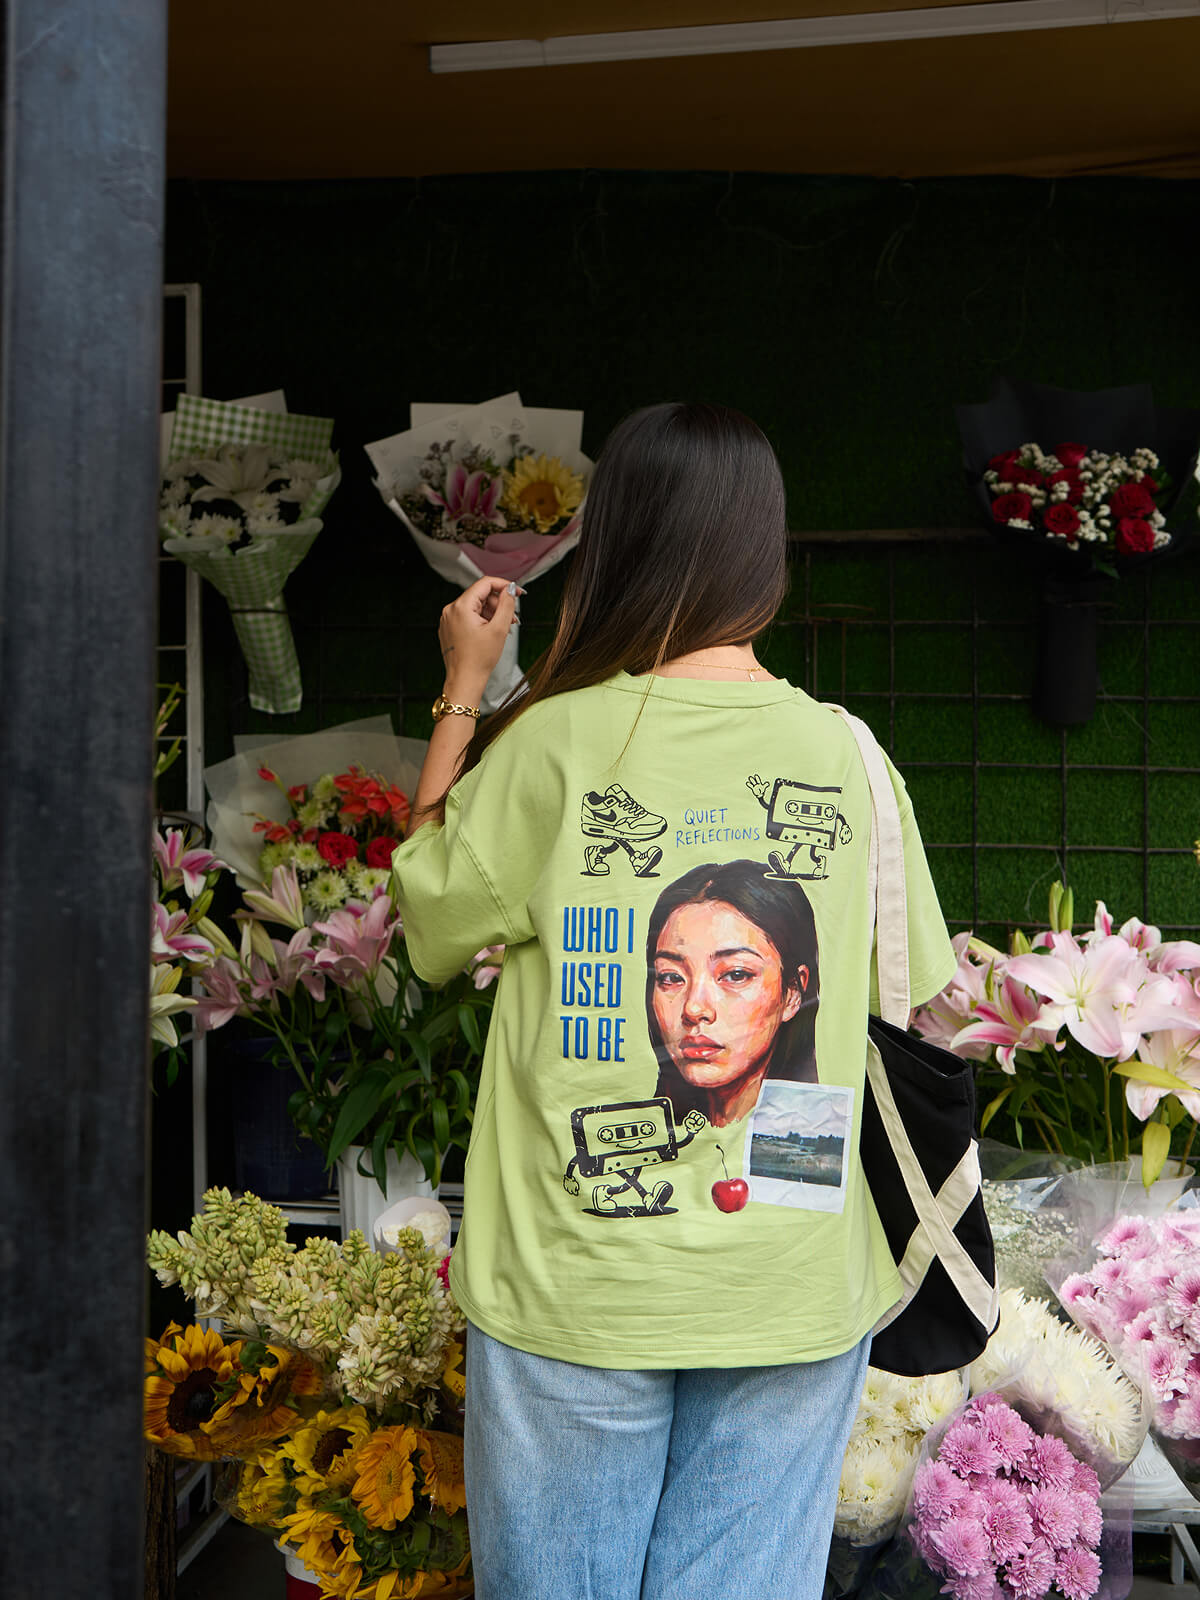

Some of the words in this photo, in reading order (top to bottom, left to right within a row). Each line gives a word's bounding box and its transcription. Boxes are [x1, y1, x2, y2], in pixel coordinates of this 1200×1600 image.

[676, 826, 761, 848] REFLECTIONS
[684, 807, 728, 826] QUIET
[562, 906, 619, 954] WHO
[627, 907, 635, 954] I
[561, 961, 622, 1008] USED
[559, 1015, 589, 1060] TO
[597, 1016, 626, 1062] BE
